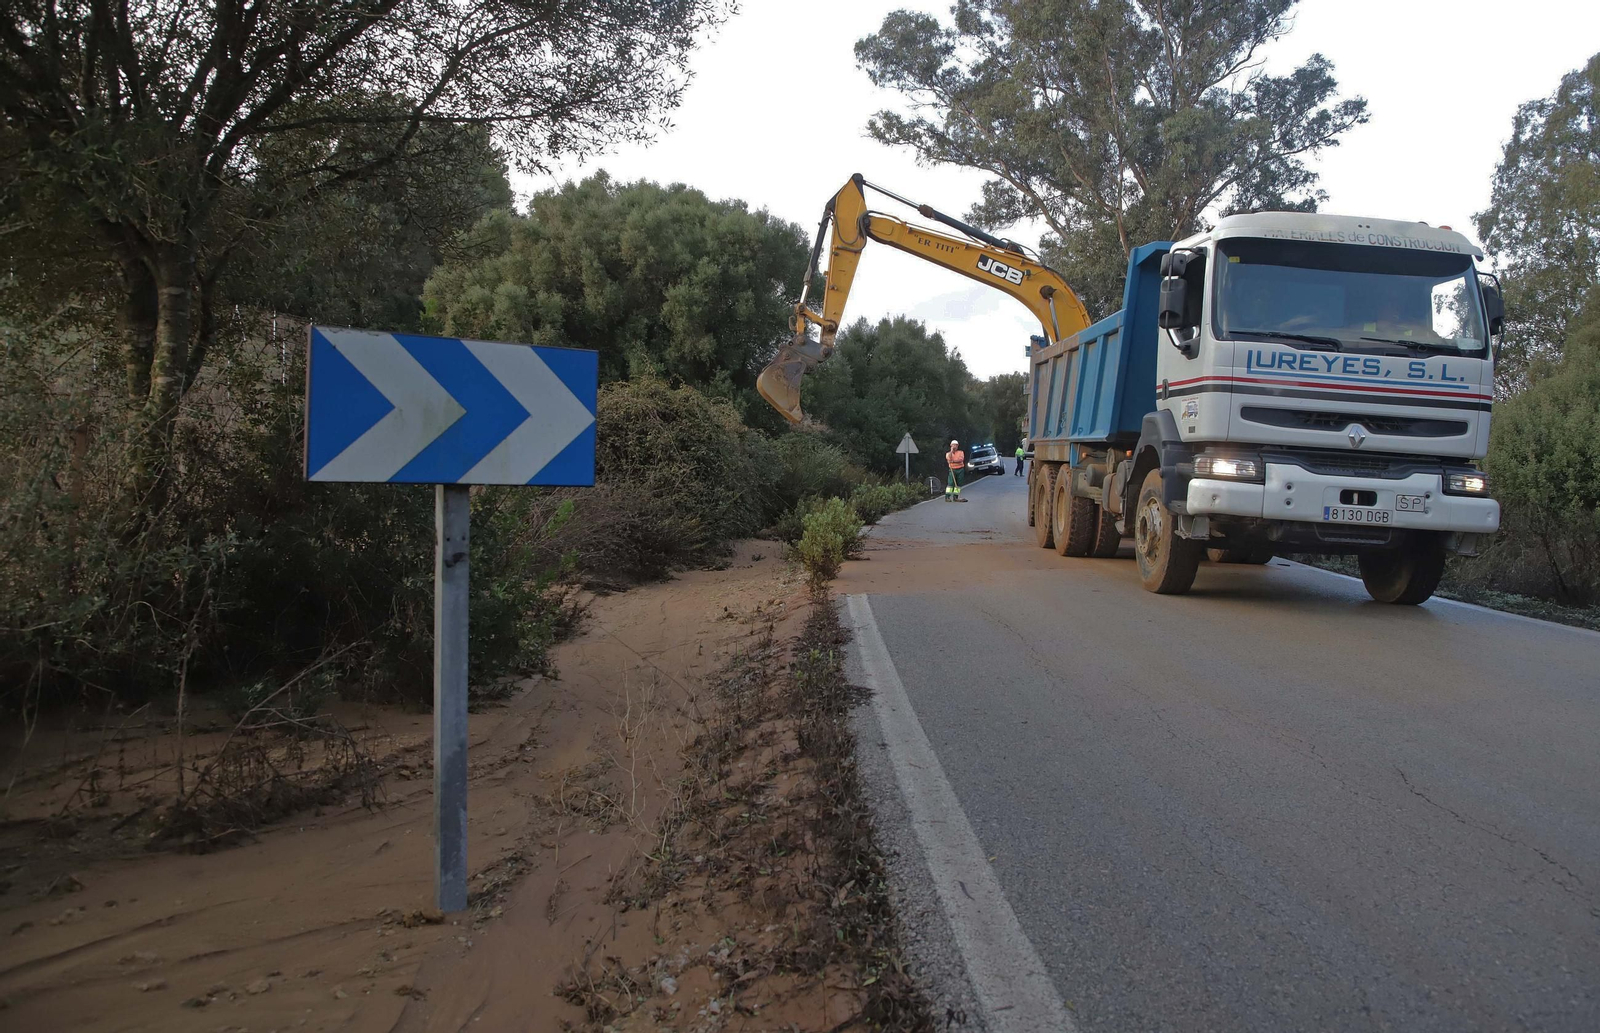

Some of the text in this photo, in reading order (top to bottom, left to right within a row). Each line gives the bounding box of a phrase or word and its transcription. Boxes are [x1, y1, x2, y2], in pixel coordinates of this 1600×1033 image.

[1348, 231, 1365, 243] de
[977, 258, 1024, 285] JCB
[1247, 349, 1392, 378] LUREYES,
[1399, 497, 1422, 510] SP
[1331, 508, 1389, 523] 8130 DGB
